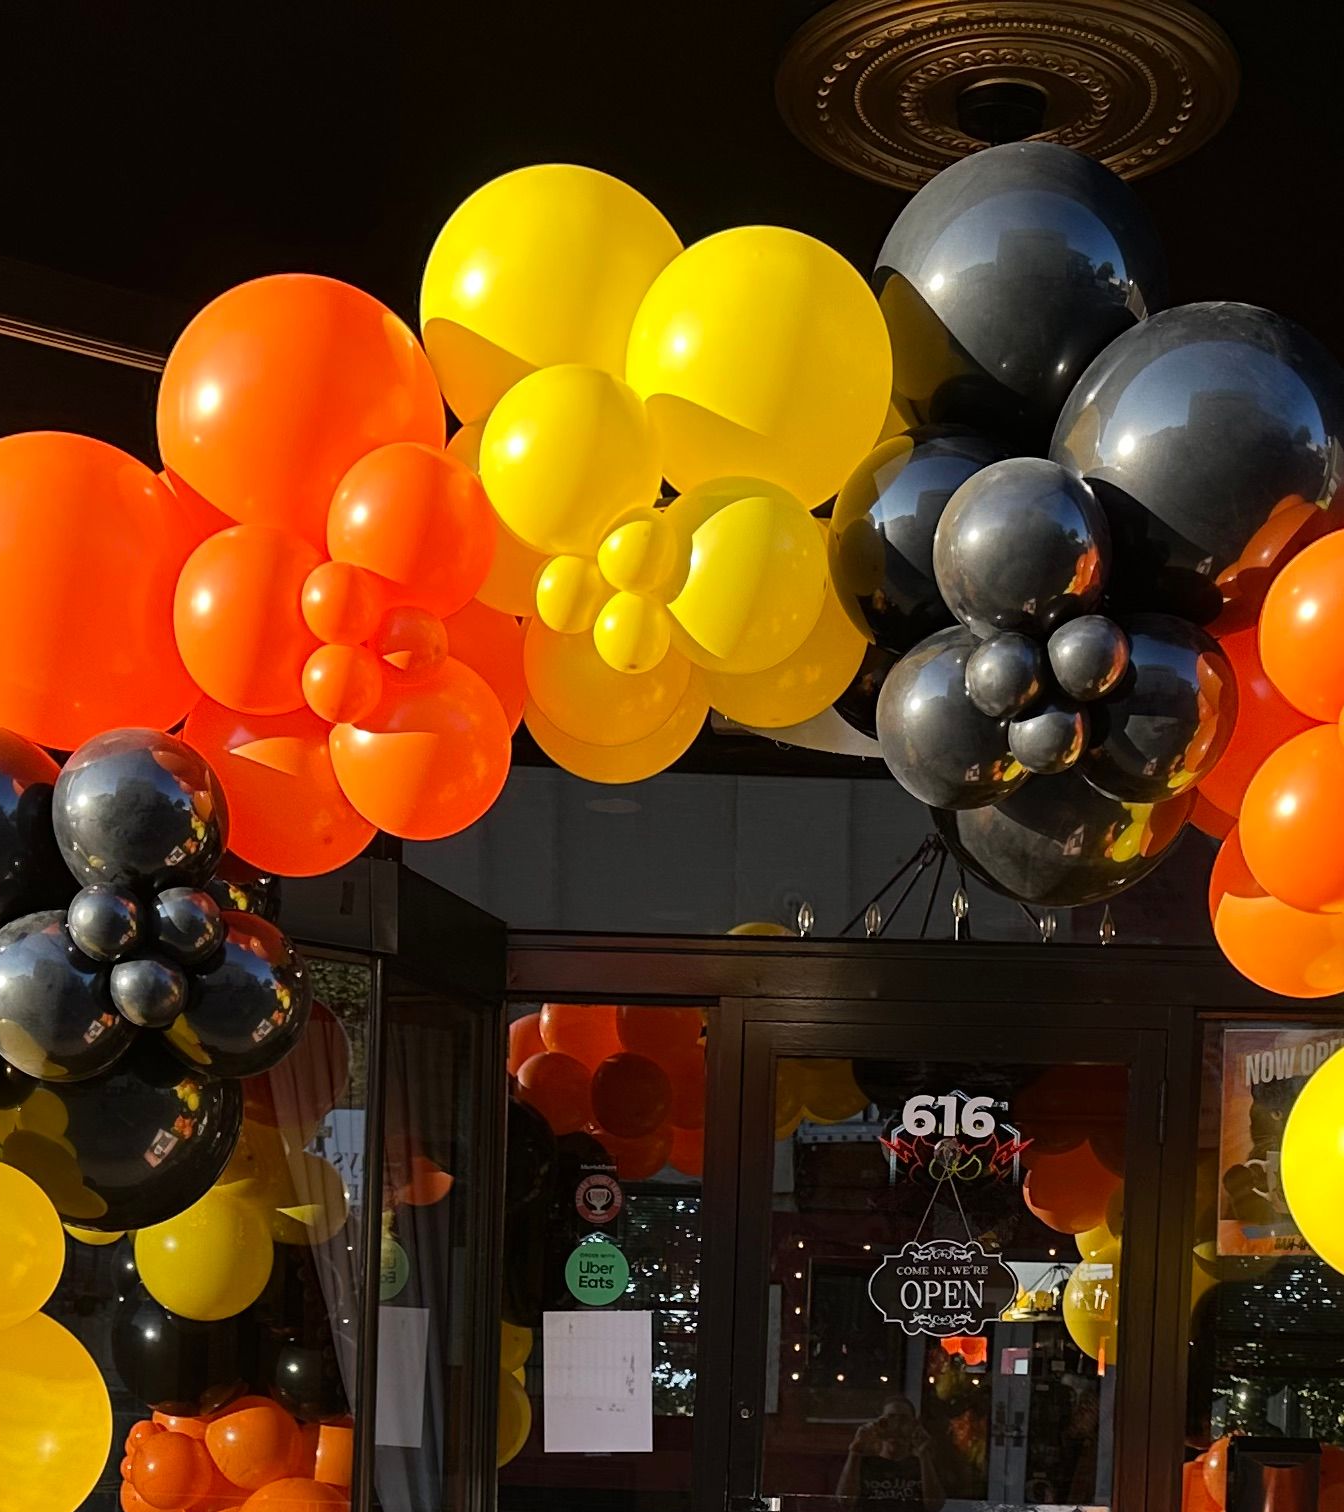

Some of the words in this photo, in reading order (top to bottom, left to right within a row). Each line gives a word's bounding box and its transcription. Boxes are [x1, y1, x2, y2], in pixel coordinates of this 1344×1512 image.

[1245, 1047, 1295, 1087] NOW
[902, 1094, 996, 1138] 616
[579, 1260, 615, 1275] Uber
[896, 1266, 929, 1276] COME
[951, 1264, 989, 1275] WE'RE
[578, 1275, 615, 1289] Eats
[900, 1279, 985, 1310] OPEN
